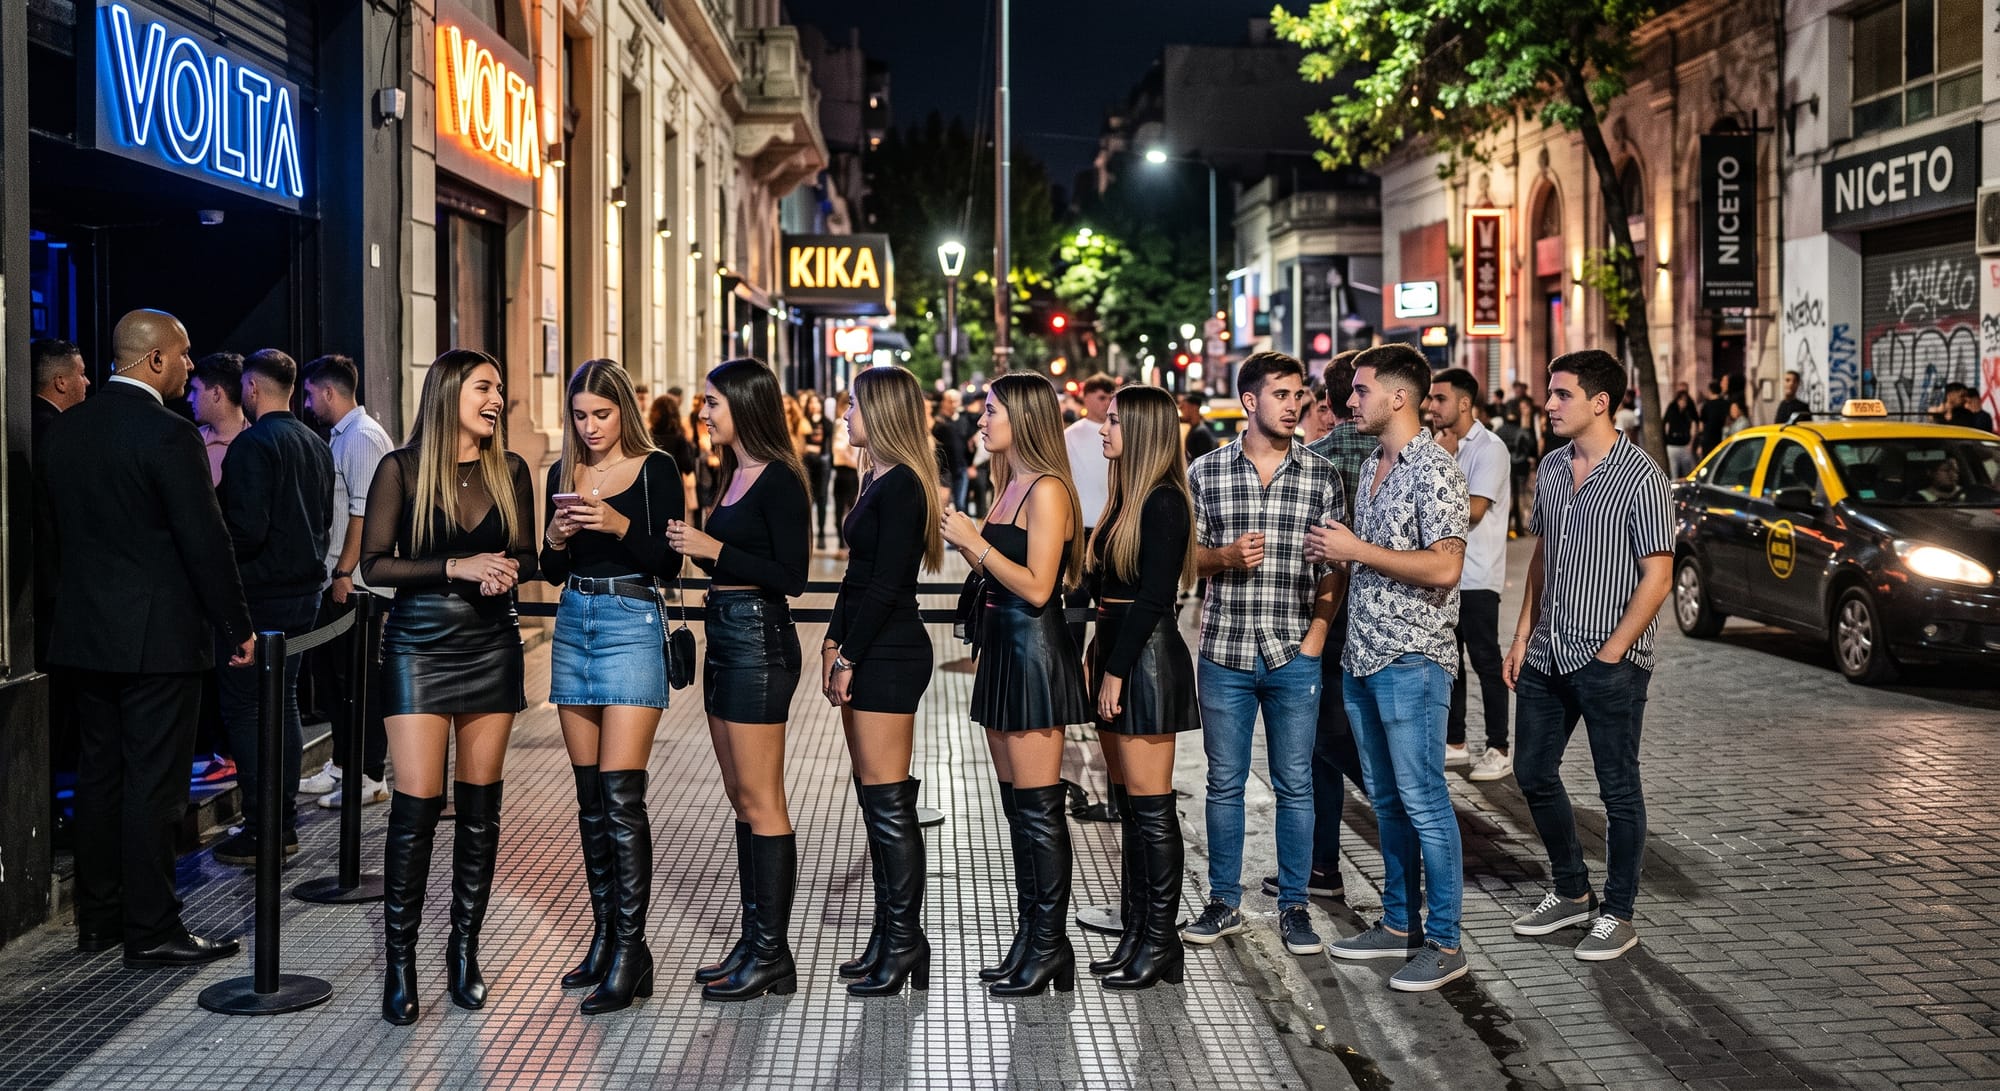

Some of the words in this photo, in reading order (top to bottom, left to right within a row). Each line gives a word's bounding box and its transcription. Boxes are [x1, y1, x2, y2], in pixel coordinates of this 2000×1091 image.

[112, 4, 303, 197] VOLTA
[449, 26, 541, 177] VOLTA
[1717, 156, 1739, 264] NICETO
[1835, 146, 1953, 213] NICETO
[790, 247, 879, 288] KIKA
